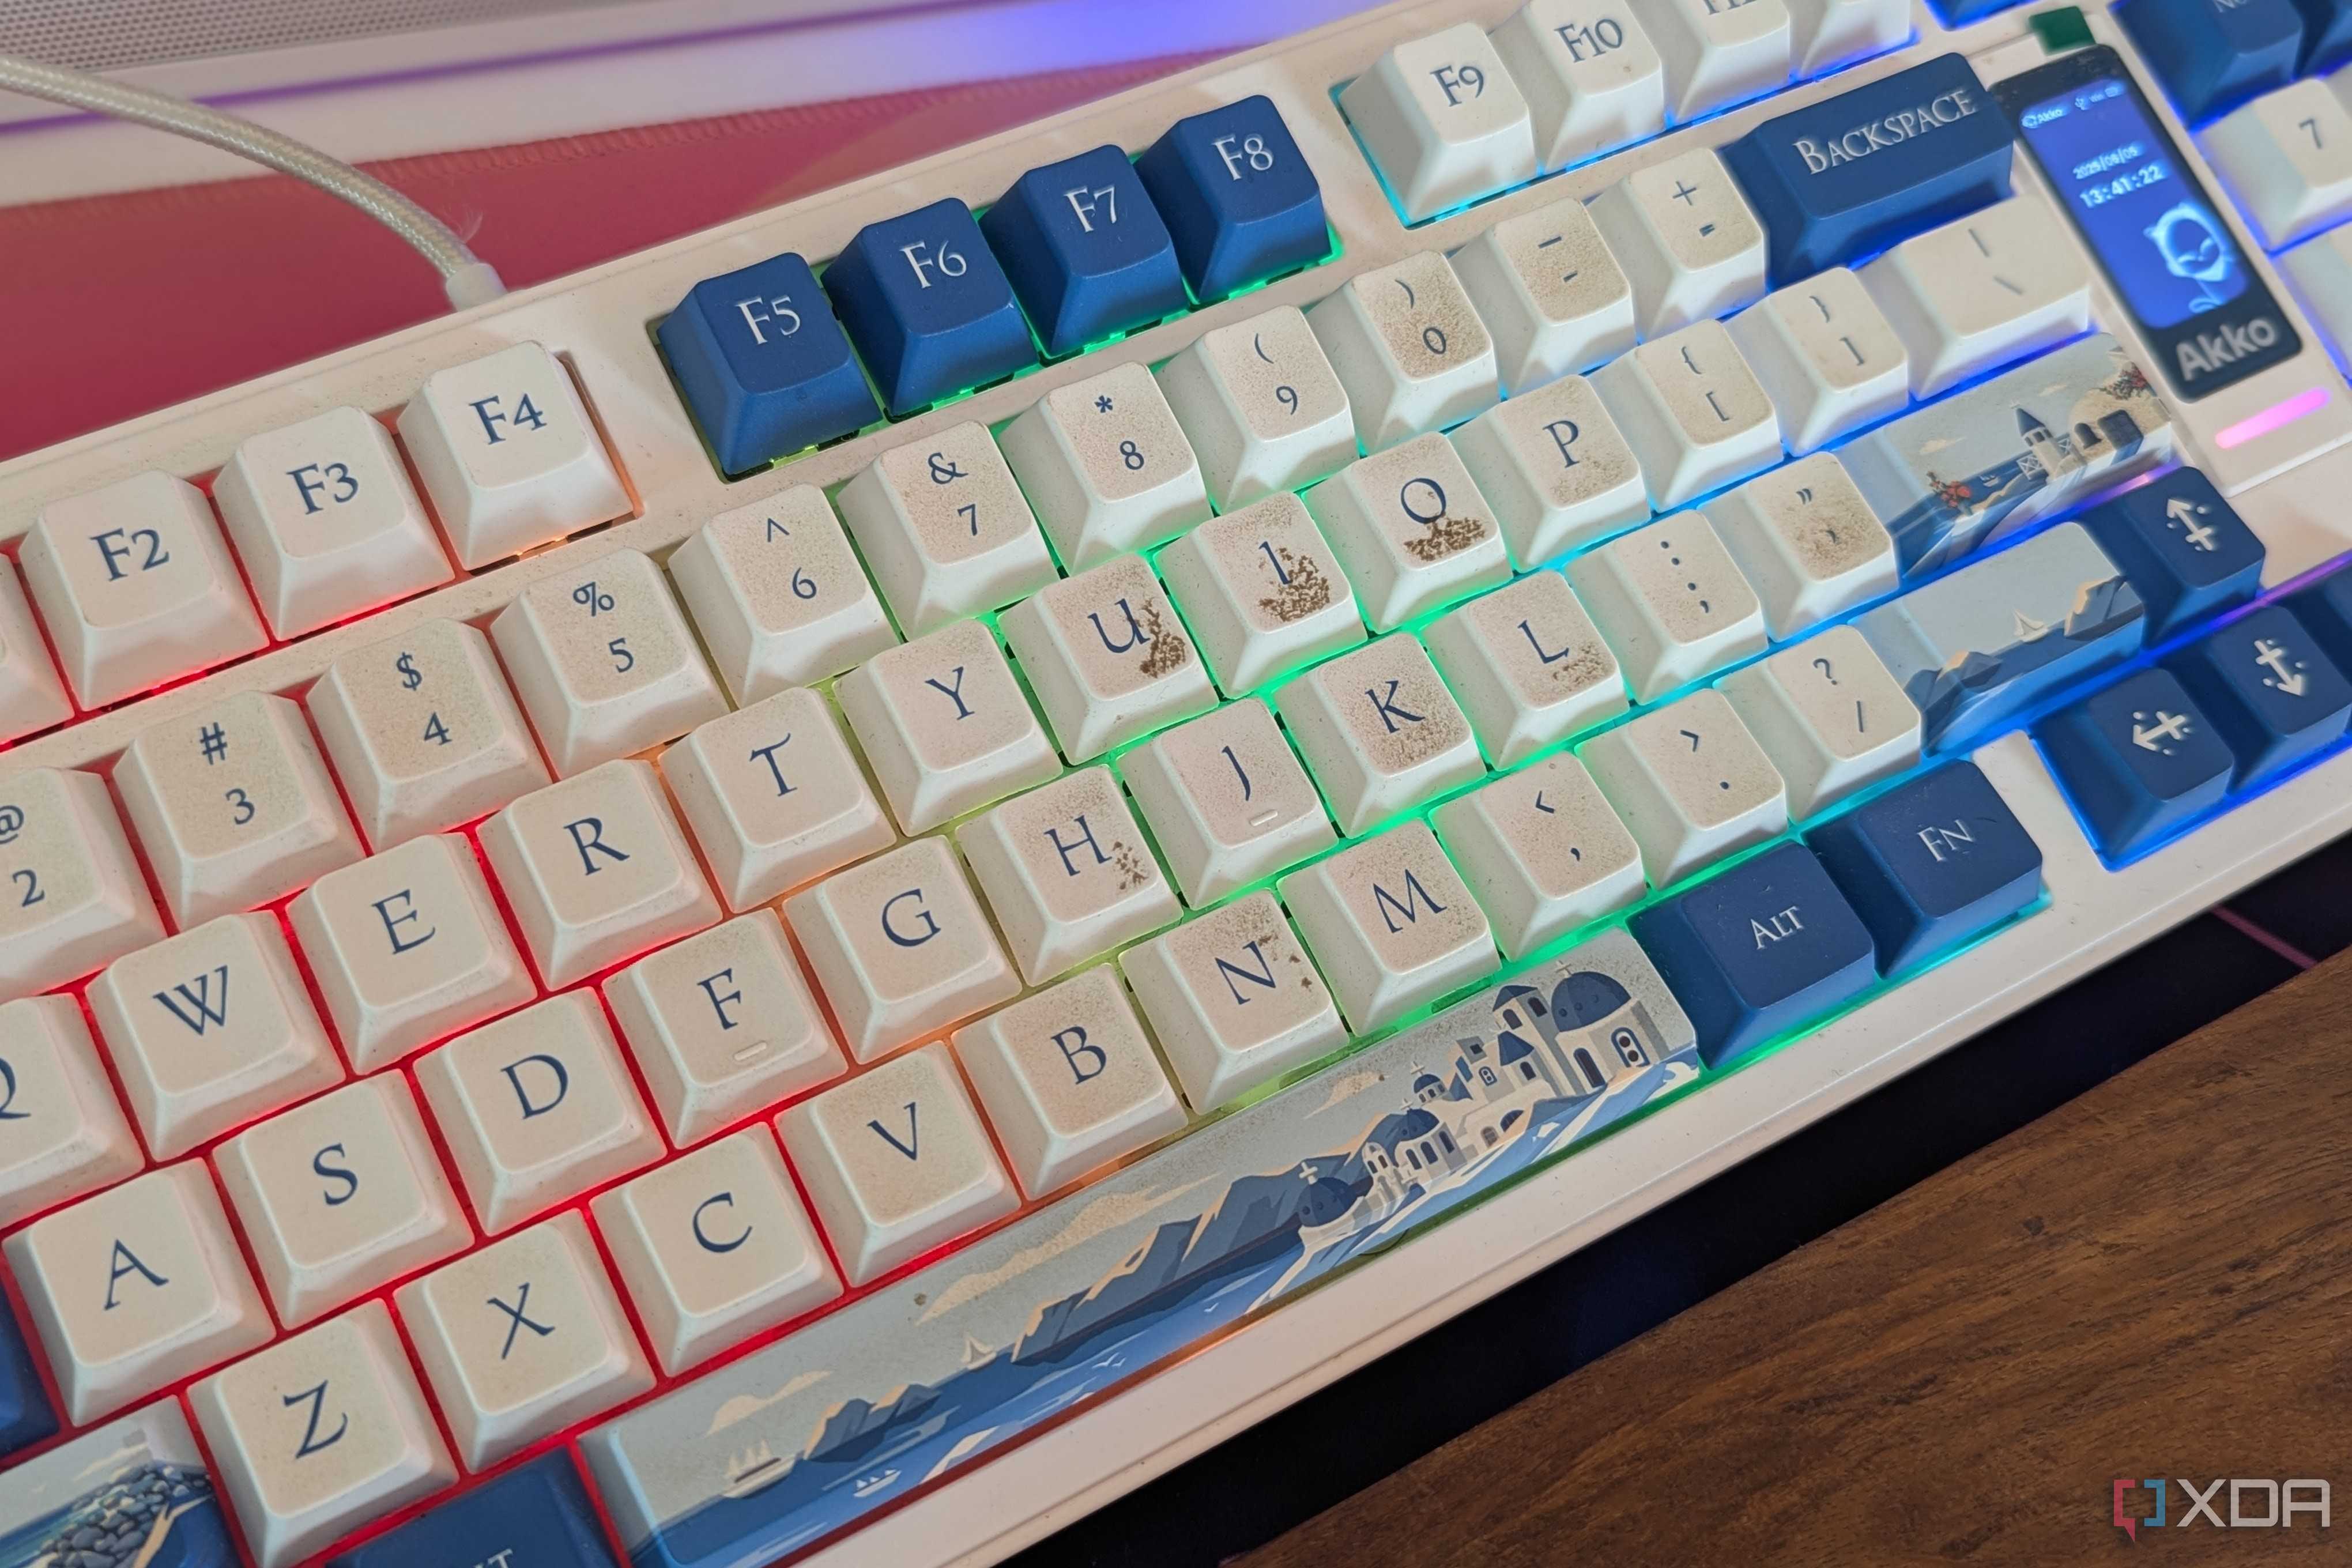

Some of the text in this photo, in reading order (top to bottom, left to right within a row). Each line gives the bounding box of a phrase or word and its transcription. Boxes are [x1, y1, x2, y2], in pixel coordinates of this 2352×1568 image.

[1553, 17, 1624, 63] F10
[1429, 64, 1485, 107] F9
[2298, 117, 2324, 150] 7
[1212, 136, 1273, 181] F8
[1064, 186, 1117, 233] F7
[1672, 180, 1698, 206] +
[2079, 164, 2166, 208] 13:41:22
[900, 241, 967, 289] F6
[736, 296, 801, 345] F5
[1422, 326, 1448, 355] 0
[1254, 332, 1273, 364] (
[2175, 318, 2278, 382] Akko
[468, 393, 548, 446] F4
[1275, 385, 1299, 416] 9
[927, 451, 970, 485] &
[1119, 440, 1145, 471] 8
[1542, 419, 1580, 469] P
[285, 462, 359, 515] F3
[1400, 477, 1448, 526] O
[957, 503, 978, 536] 7
[89, 527, 170, 582] F2
[572, 581, 615, 617] %
[791, 567, 817, 600] 6
[1687, 582, 1710, 615] ;
[1087, 597, 1151, 654] U
[1517, 619, 1570, 665] L
[395, 651, 423, 692] $
[608, 636, 635, 673] 5
[1812, 657, 1837, 684] ?
[924, 665, 975, 721] Y
[1364, 680, 1426, 734] K
[199, 721, 228, 766] #
[423, 712, 453, 745] 4
[749, 732, 796, 797] T
[1221, 745, 1252, 802] J
[225, 787, 255, 826] 3
[563, 817, 631, 876] R
[1043, 814, 1113, 877] H
[12, 869, 46, 908] 2
[1373, 868, 1448, 933] M
[372, 888, 436, 955] E
[881, 888, 942, 948] G
[1216, 940, 1277, 1006] N
[152, 964, 228, 1036] W
[699, 967, 741, 1031] F
[1051, 1026, 1107, 1085] B
[501, 1054, 569, 1120] D
[866, 1101, 918, 1162] V
[312, 1143, 359, 1206] S
[692, 1191, 753, 1254] C
[103, 1239, 169, 1311] A
[487, 1281, 555, 1358] X
[282, 1379, 348, 1460] Z
